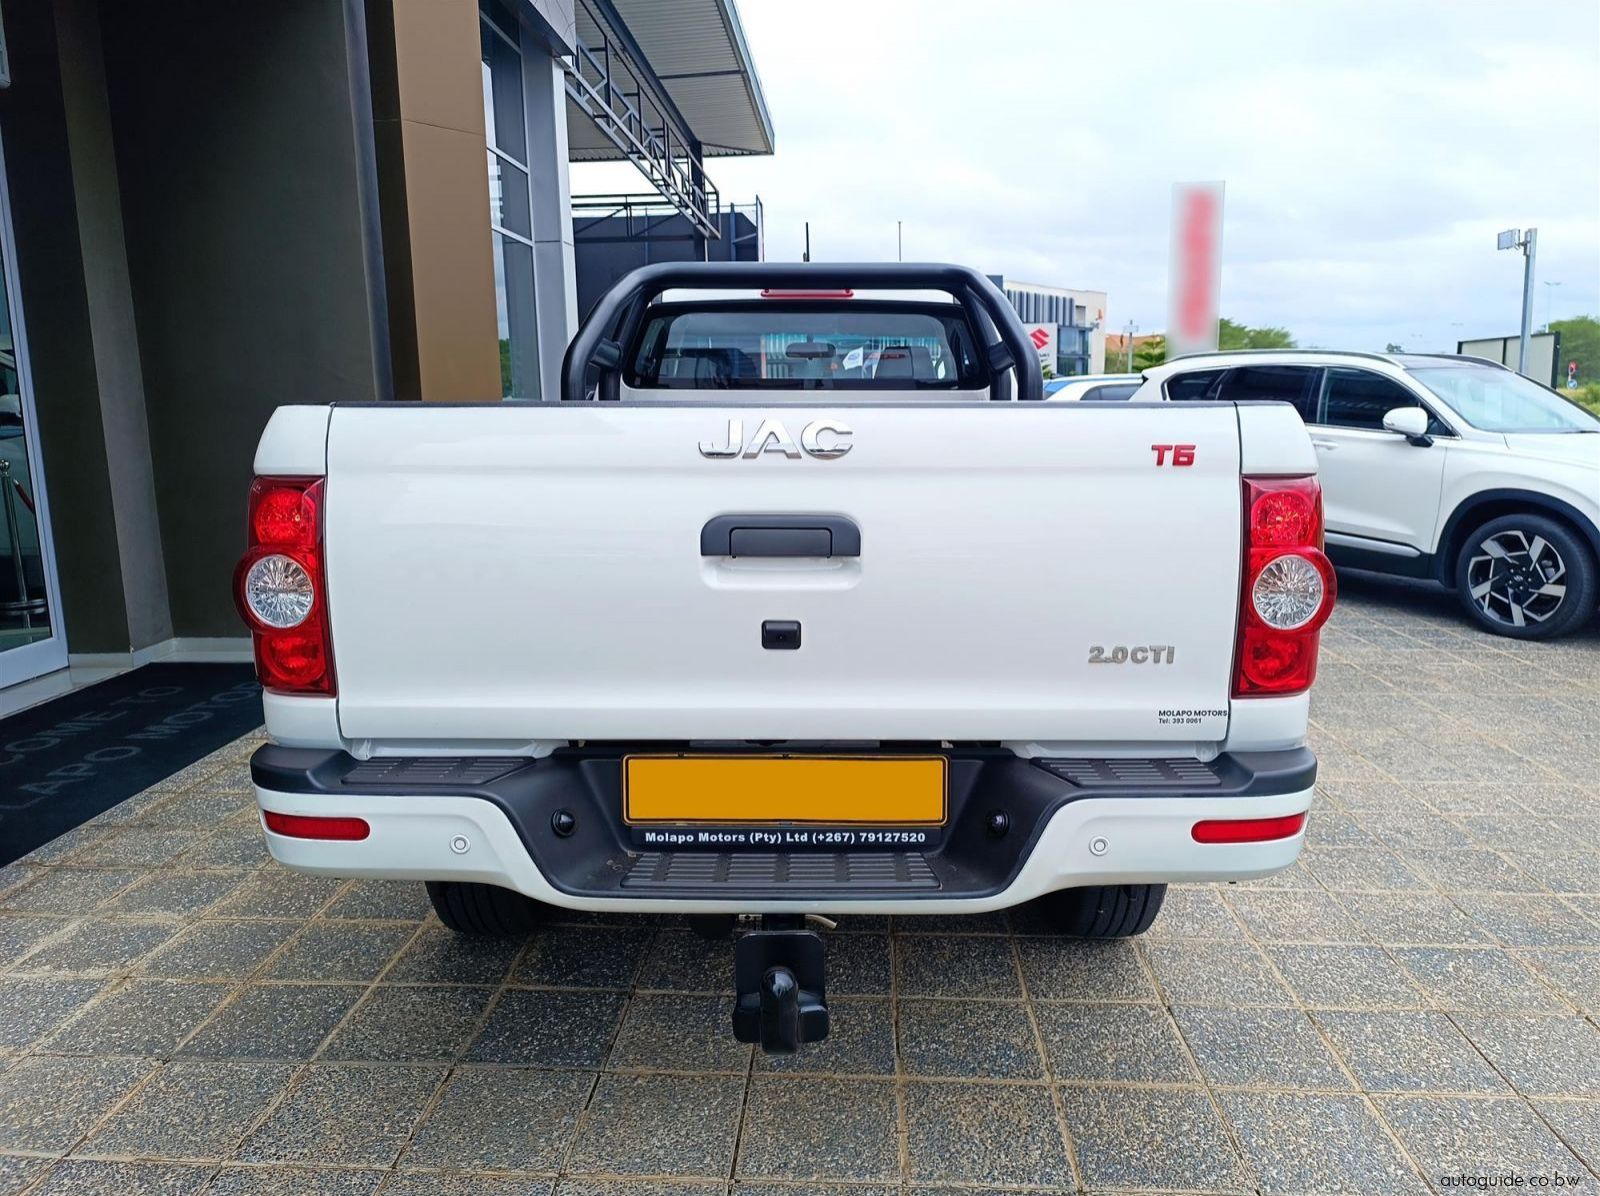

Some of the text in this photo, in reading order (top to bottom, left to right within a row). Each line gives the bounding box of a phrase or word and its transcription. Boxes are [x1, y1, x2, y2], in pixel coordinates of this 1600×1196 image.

[698, 418, 853, 460] JAC
[1151, 444, 1196, 466] T6
[1088, 645, 1175, 664] 2.0CTI
[1158, 709, 1228, 717] MOLAPO MOTORS
[645, 831, 926, 844] Molapo Motors (Pty) Ltd (+267) 79127520
